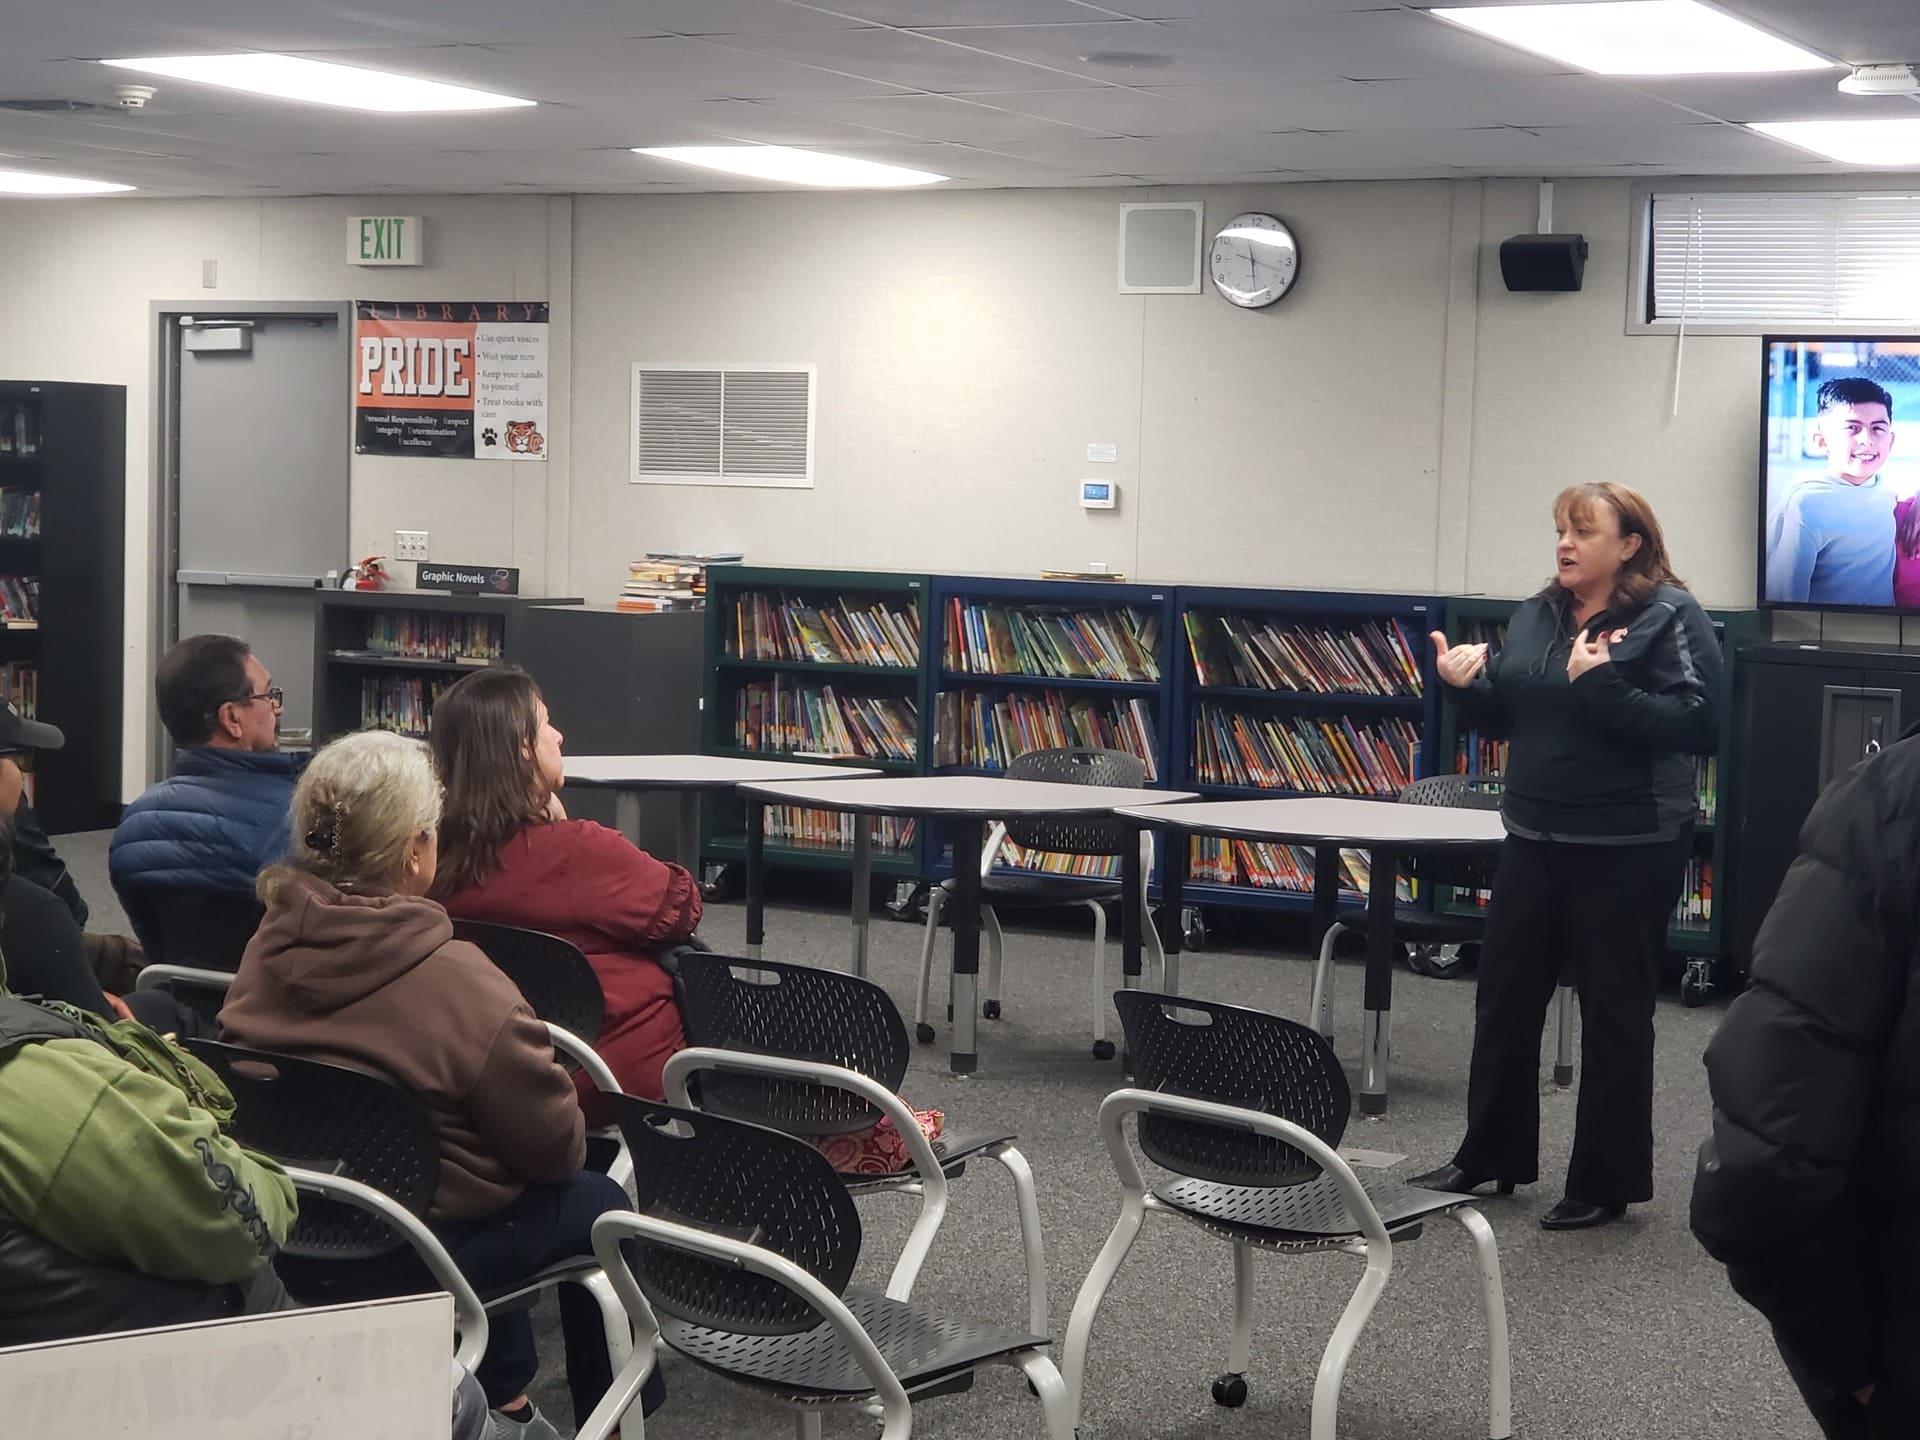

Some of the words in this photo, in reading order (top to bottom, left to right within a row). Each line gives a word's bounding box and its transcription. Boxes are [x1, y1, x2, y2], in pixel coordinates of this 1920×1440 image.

[1252, 217, 1263, 227] 12
[360, 218, 405, 260] EXIT
[1215, 254, 1222, 263] 9
[1285, 257, 1292, 267] 3
[1218, 273, 1225, 283] 8
[1279, 277, 1285, 285] 4
[369, 303, 535, 321] LIBRARY
[481, 334, 495, 343] Use
[496, 335, 515, 344] quiet
[516, 335, 540, 343] voices
[481, 351, 498, 361] Wait
[500, 354, 518, 363] your
[359, 336, 471, 398] PRIDE
[481, 370, 501, 380] Keep
[502, 372, 519, 381] your
[520, 370, 544, 379] hands
[490, 383, 520, 392] yourself
[482, 397, 501, 407] Treat
[502, 398, 525, 407] books
[526, 398, 544, 407] with
[391, 415, 437, 426] Responsibility
[376, 426, 402, 436] Integrity
[408, 426, 457, 436] Determination
[422, 571, 454, 583] Graphic
[456, 573, 485, 584] Novels
